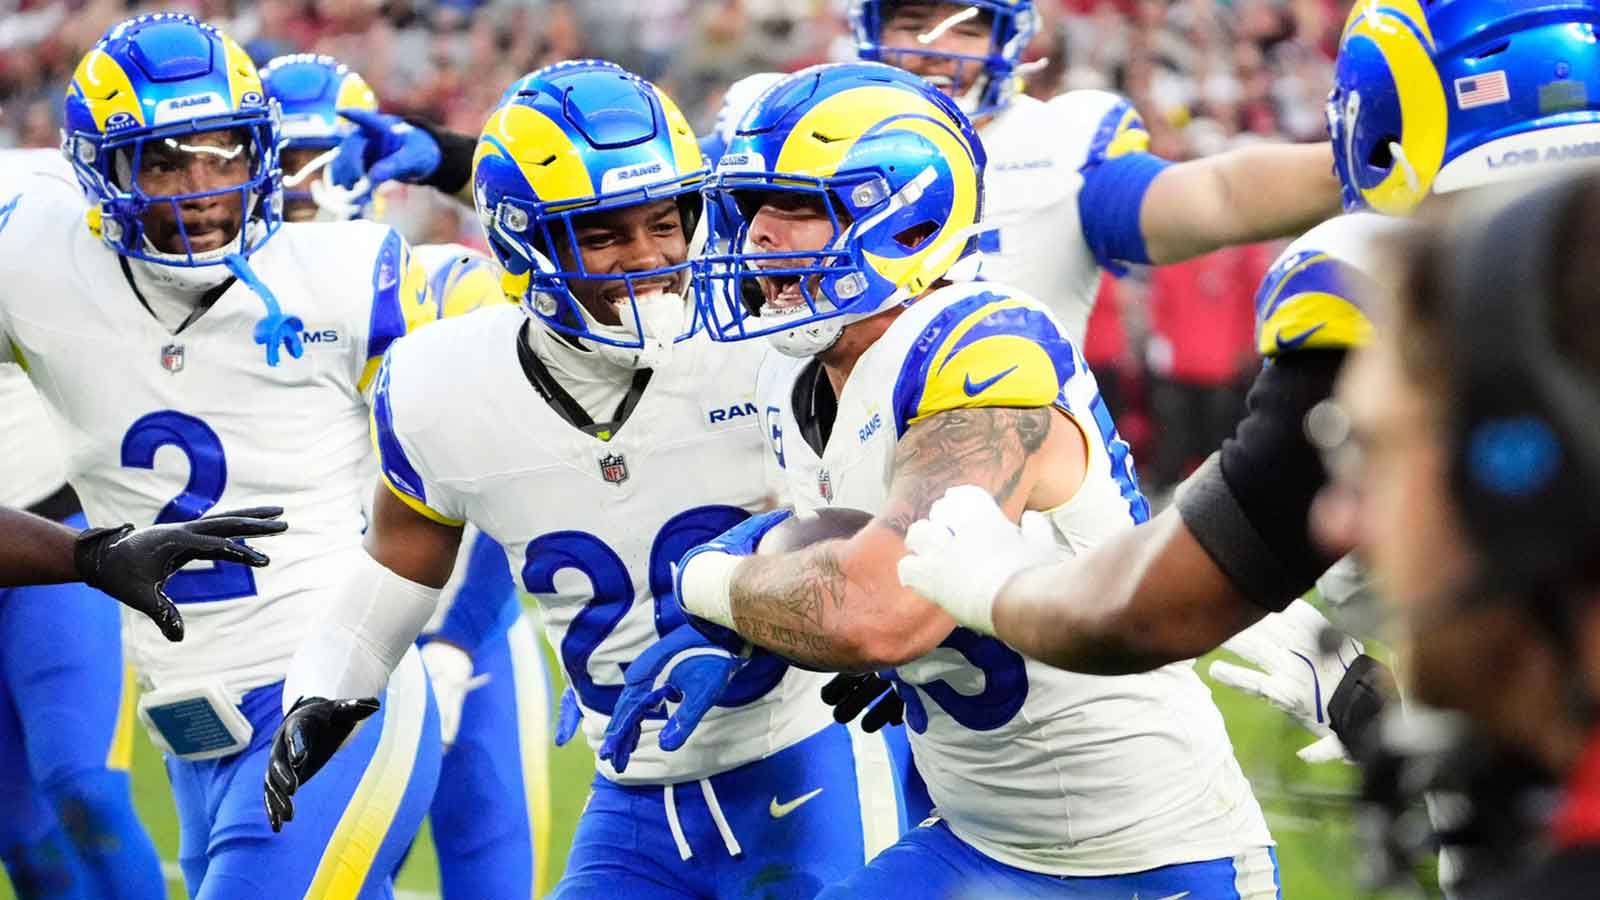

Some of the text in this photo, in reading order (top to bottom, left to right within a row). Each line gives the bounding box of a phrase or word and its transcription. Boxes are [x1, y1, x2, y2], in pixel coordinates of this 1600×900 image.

[617, 163, 661, 181] RAMS
[302, 329, 338, 344] MS
[709, 402, 758, 424] RAM
[858, 412, 882, 444] RAMS
[120, 409, 258, 605] 2
